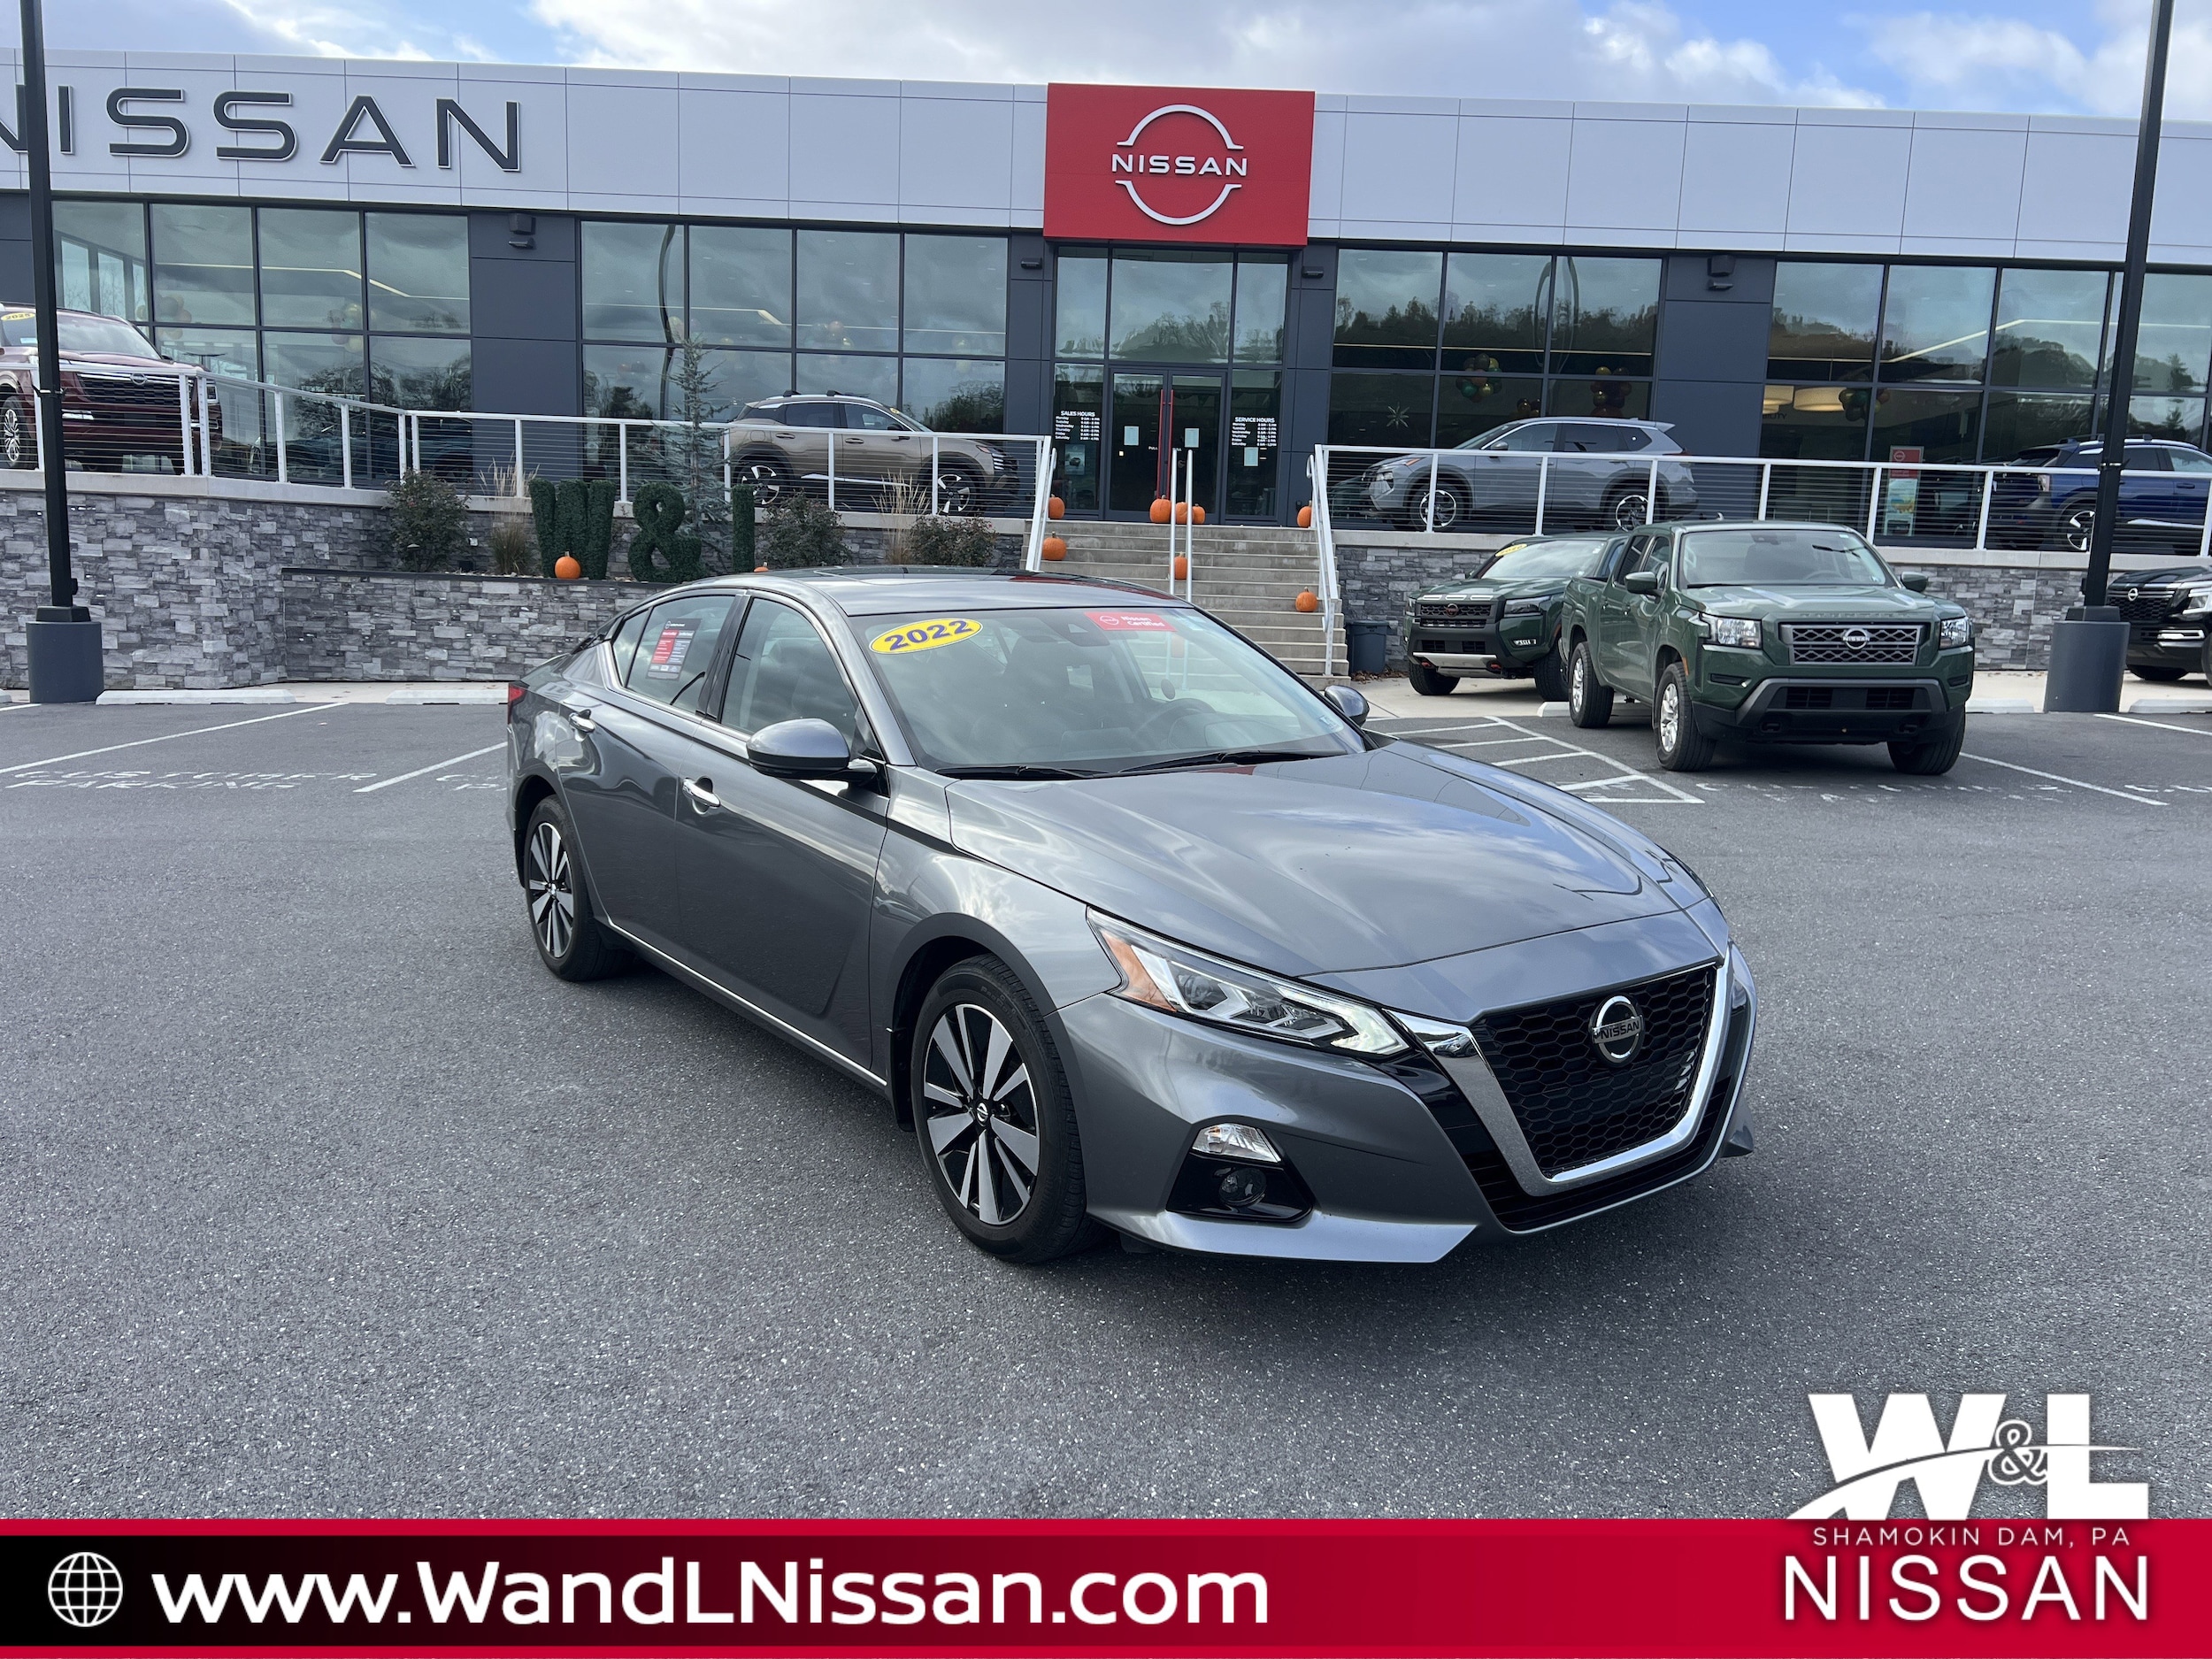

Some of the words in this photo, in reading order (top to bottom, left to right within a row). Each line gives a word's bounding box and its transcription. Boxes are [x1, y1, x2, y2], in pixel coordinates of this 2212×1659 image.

[0, 84, 520, 173] ISSAN
[1111, 153, 1248, 176] NISSAN
[885, 620, 973, 650] 2022
[1601, 1020, 1640, 1040] NISSAN
